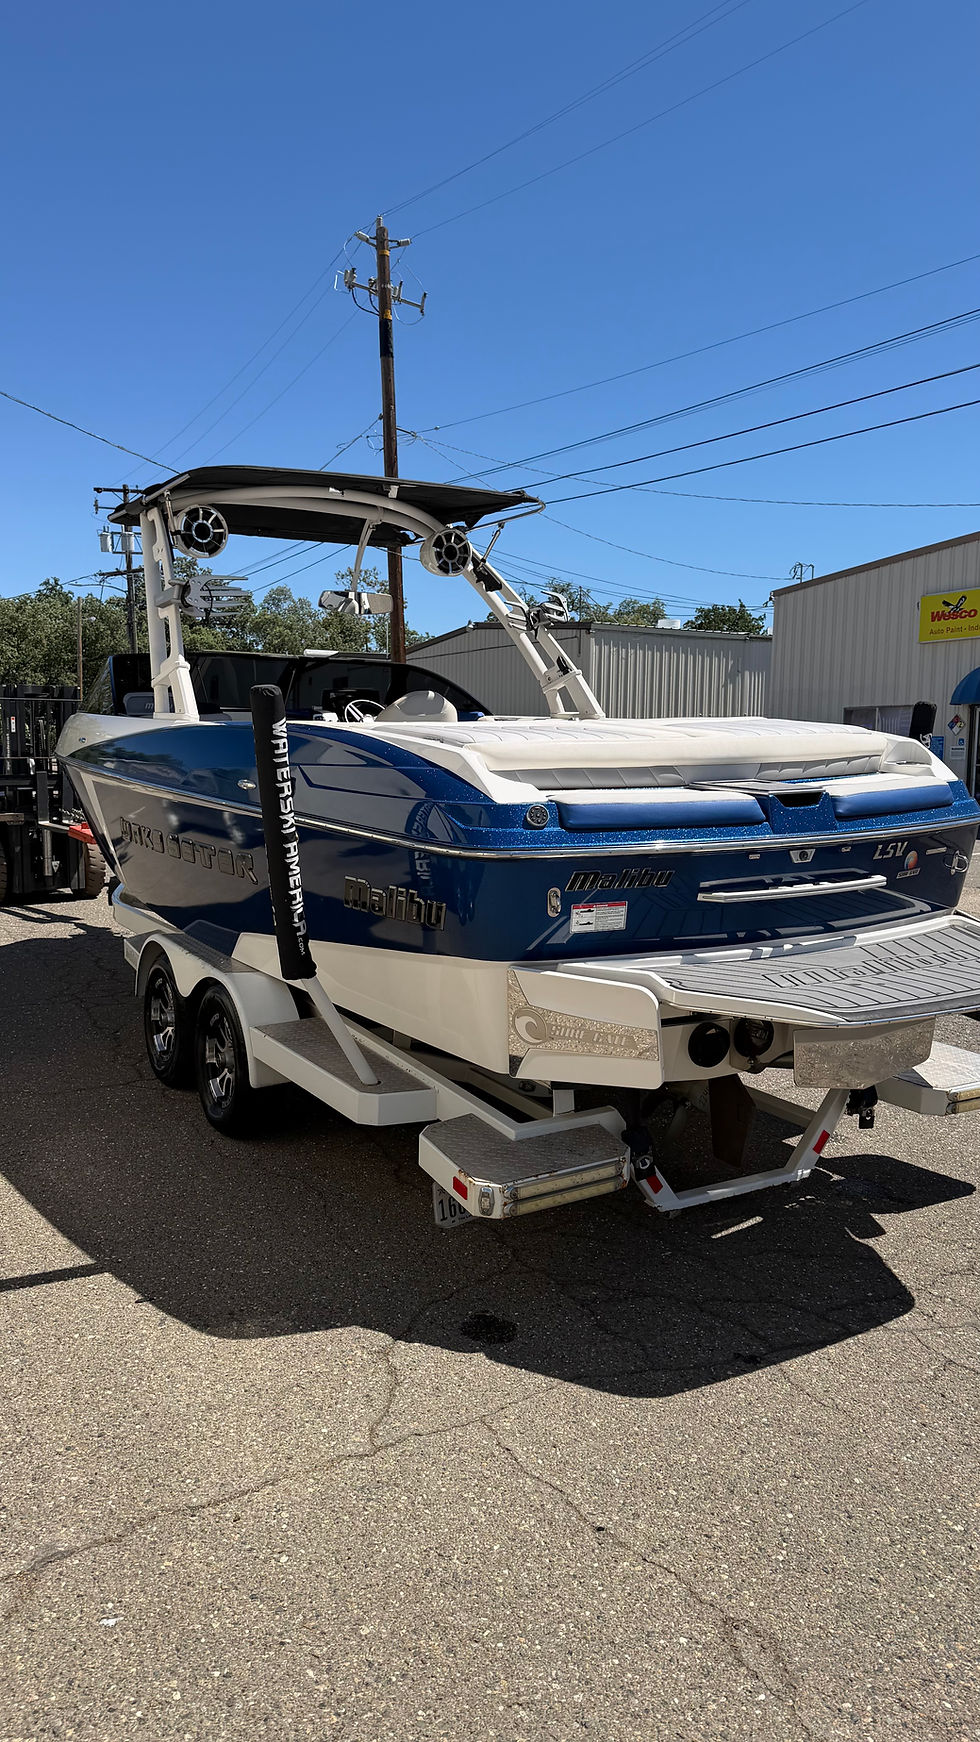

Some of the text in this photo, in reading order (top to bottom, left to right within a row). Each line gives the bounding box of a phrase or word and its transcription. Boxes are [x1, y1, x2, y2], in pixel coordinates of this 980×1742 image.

[930, 609, 978, 622] Wesco
[929, 627, 945, 635] Auto
[945, 625, 963, 634] Paint
[270, 716, 296, 834] WATERSKI
[872, 841, 908, 860] LSV
[564, 867, 675, 892] Malibu
[343, 875, 447, 930] Malibu
